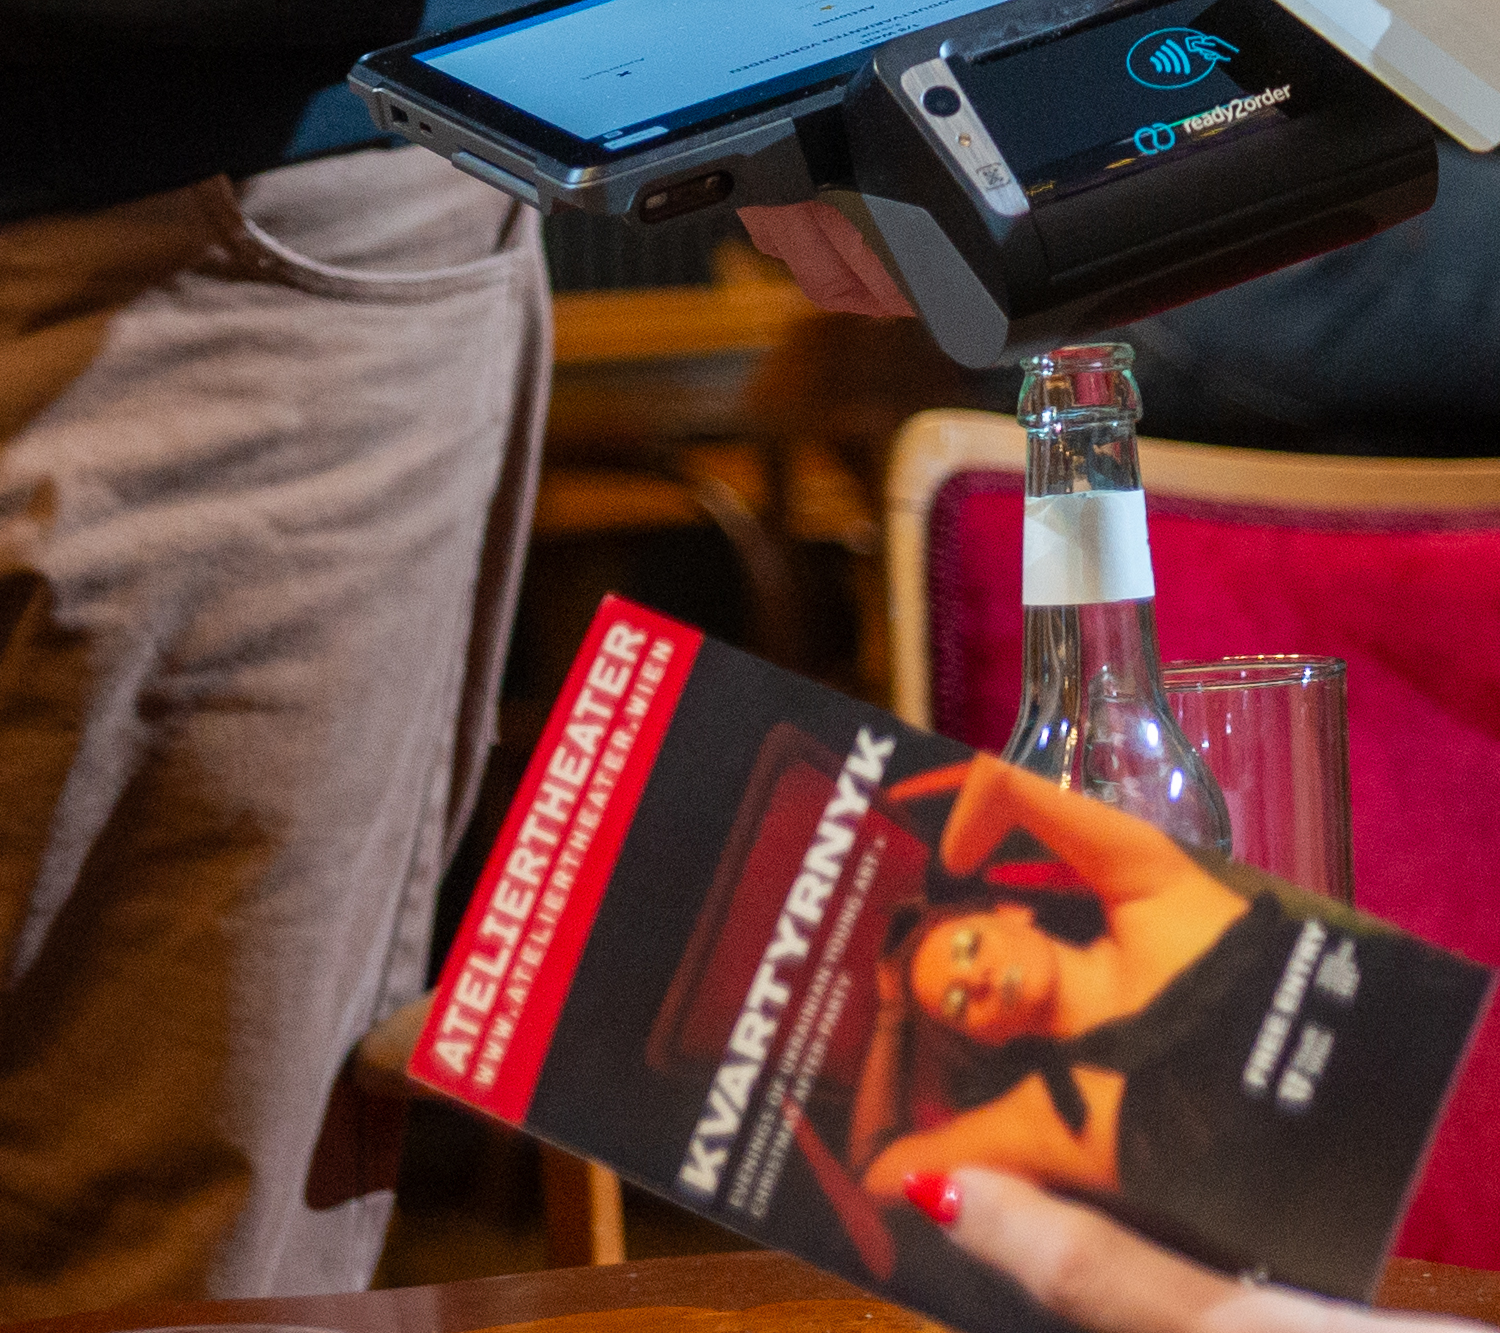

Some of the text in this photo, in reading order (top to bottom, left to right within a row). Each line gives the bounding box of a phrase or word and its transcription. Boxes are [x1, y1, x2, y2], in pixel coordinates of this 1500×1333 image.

[728, 42, 820, 73] VORHANDEN
[812, 5, 876, 26] Aktionen
[1182, 84, 1292, 134] ready2order
[434, 621, 648, 1075] ATELIERTHEATER
[470, 637, 677, 1089] WWW.ATELIERTHEATER.WIEN
[677, 725, 899, 1196] KVARTYRNYK
[766, 1077, 788, 1108] OF
[778, 966, 833, 1076] UKRAINIAN
[823, 895, 865, 967] YOUNG
[852, 851, 881, 894] ART
